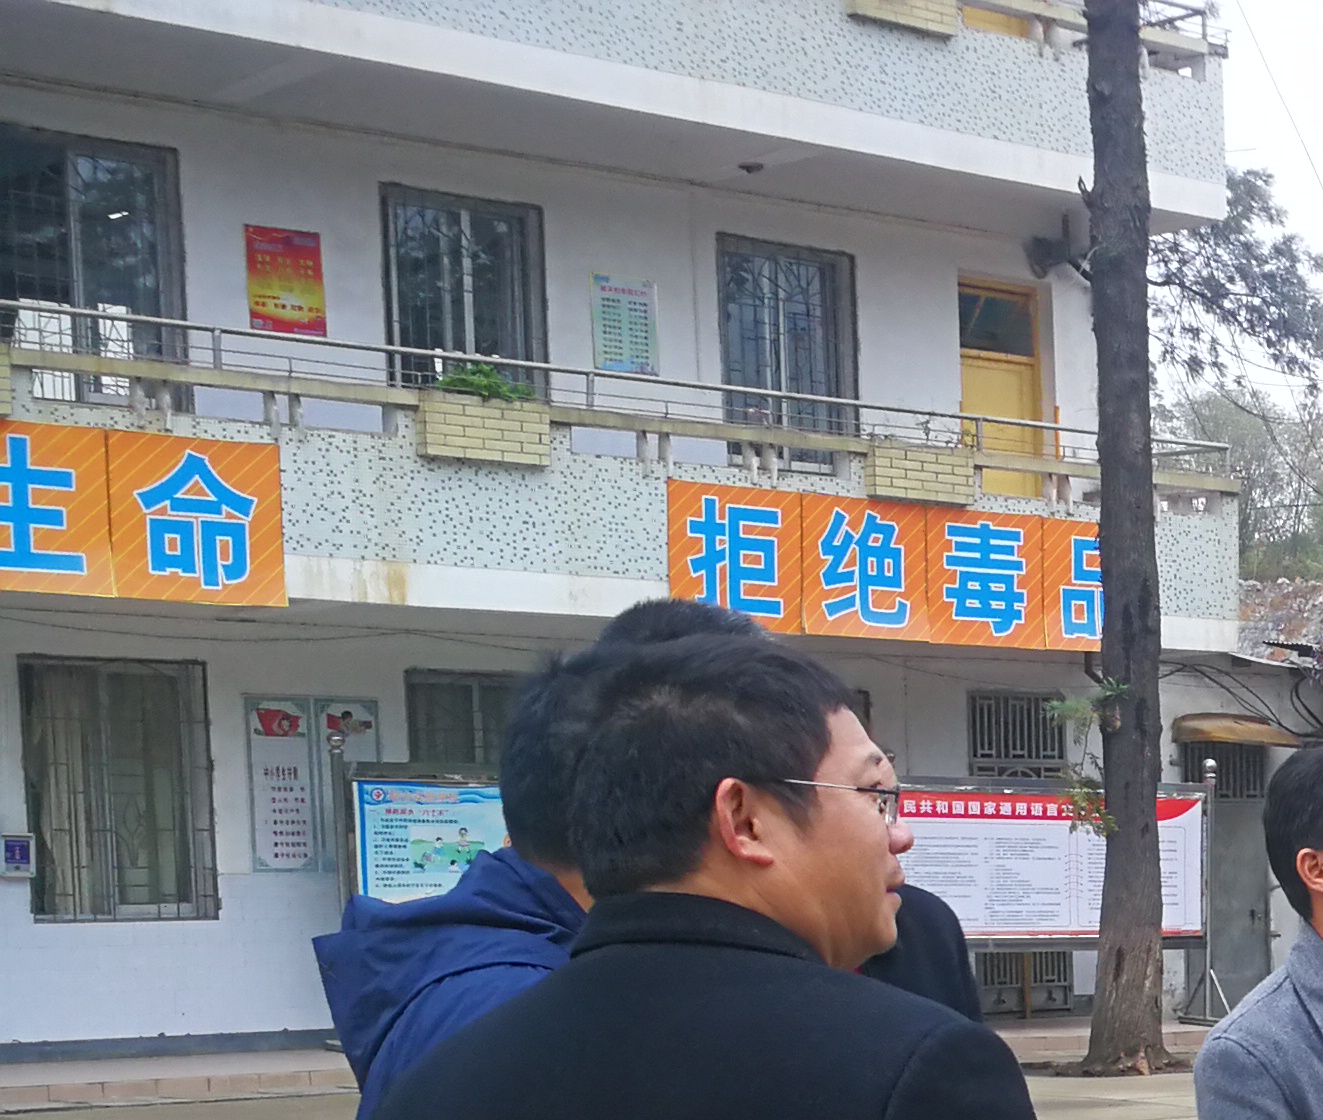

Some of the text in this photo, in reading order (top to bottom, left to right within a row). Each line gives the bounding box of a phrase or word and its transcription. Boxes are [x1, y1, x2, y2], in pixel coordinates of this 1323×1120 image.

[0, 433, 257, 590] 生命
[687, 495, 1104, 639] 拒绝毒品
[903, 799, 1100, 818] 民共和国国家通用语言文
